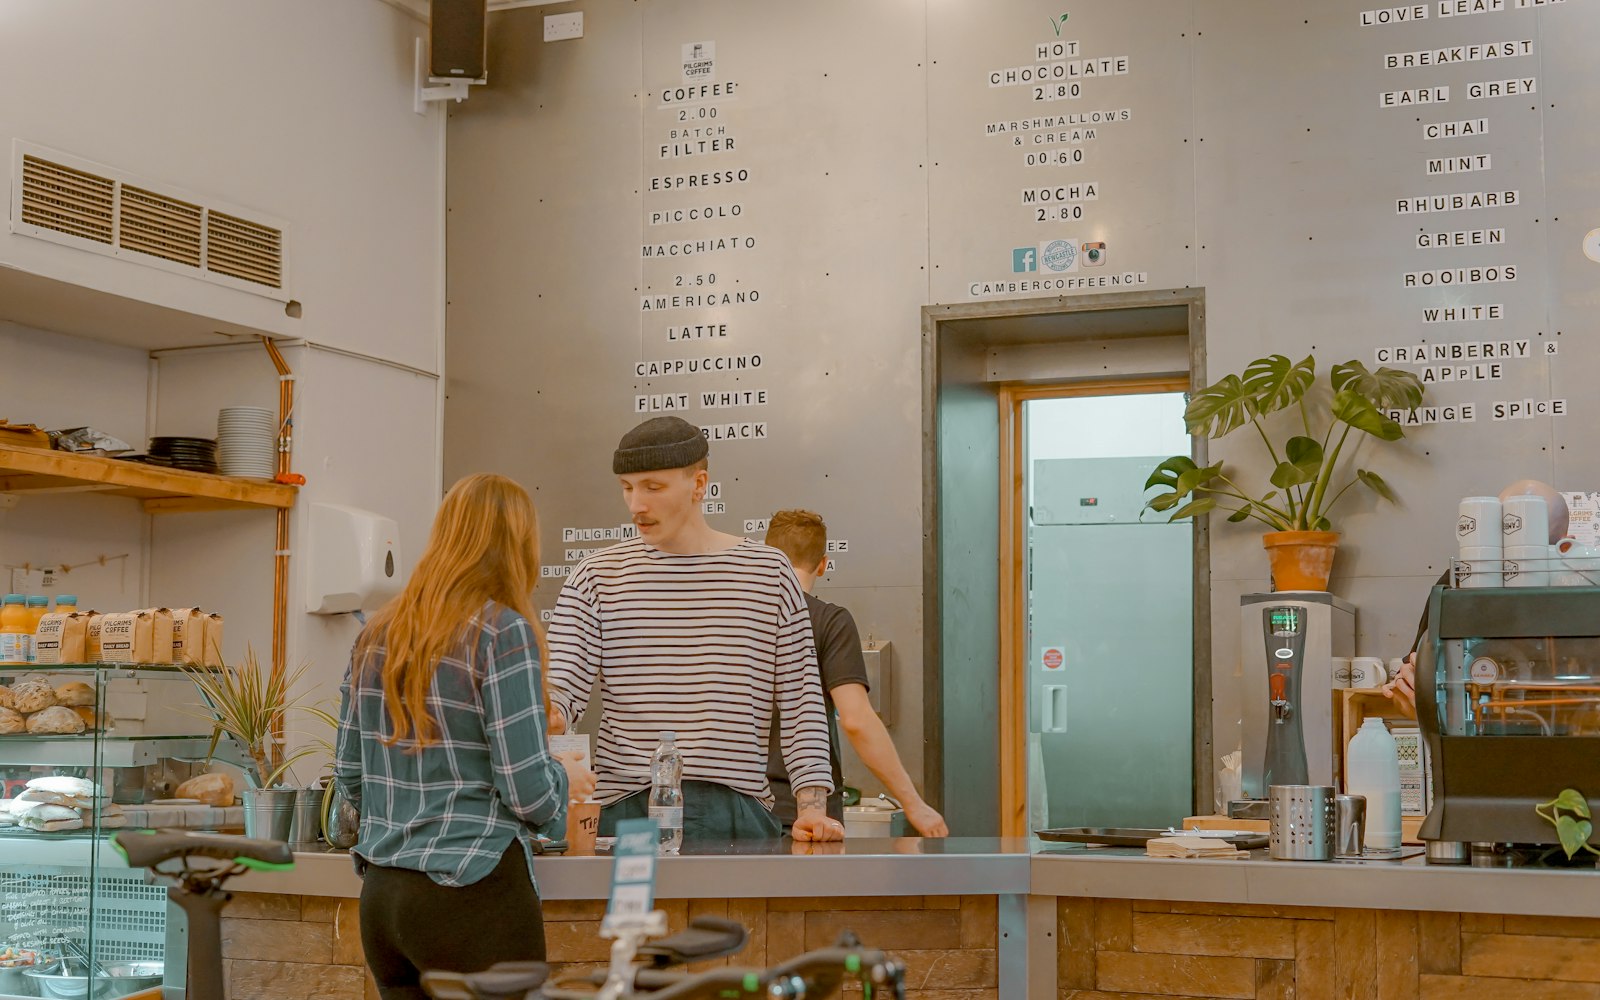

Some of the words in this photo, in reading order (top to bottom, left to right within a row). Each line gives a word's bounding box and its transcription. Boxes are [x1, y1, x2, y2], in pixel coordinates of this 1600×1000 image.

[1363, 7, 1424, 25] LOVE
[1441, 0, 1503, 15] LEAF
[1038, 43, 1076, 58] HOT
[1387, 41, 1531, 68] BREAKFAST
[683, 61, 713, 69] PILGRIMS
[686, 67, 711, 76] COFFEE
[990, 60, 1126, 84] CHOCOLATE
[662, 82, 734, 102] COFFEE
[1035, 84, 1080, 100] 2.80
[1384, 89, 1446, 105] EARL
[1469, 79, 1533, 98] GREY
[679, 107, 717, 121] 2.00
[987, 110, 1129, 133] MARSHMALLOWS
[670, 126, 725, 139] BATCH
[1014, 137, 1022, 145] &
[1034, 130, 1095, 144] CREAM
[1427, 120, 1484, 138] CHAI
[661, 138, 735, 158] FILTER
[1027, 149, 1082, 166] 00.60
[1429, 156, 1487, 173] MINT
[652, 169, 748, 190] ESPRESSO
[1023, 185, 1096, 203] MOCHA
[1397, 191, 1516, 212] RHUBARB
[653, 204, 741, 224] PICCOLO
[1037, 206, 1082, 221] 2.80
[642, 237, 756, 257] MACCHIATO
[1418, 230, 1501, 247] GREEN
[1044, 249, 1075, 262] NEWCASTLE
[675, 273, 716, 287] 2.50
[970, 274, 1145, 295] CAMBERCOFFEENCL
[1405, 267, 1516, 287] ROOIBOS
[642, 290, 759, 310] AMERICANO
[1424, 306, 1500, 321] WHITE
[669, 324, 727, 340] LATTE
[1378, 342, 1527, 362] CRANBERRY
[1547, 343, 1556, 353] &
[636, 355, 761, 376] CAPPUCCINO
[1423, 365, 1501, 382] APPLE
[639, 395, 687, 410] FLAT
[703, 391, 766, 406] WHITE
[1389, 406, 1473, 423] RANGE
[1494, 402, 1563, 418] SPICE
[701, 425, 764, 439] BLACK
[565, 527, 637, 540] PILGRIM
[105, 626, 129, 634] COFFEE
